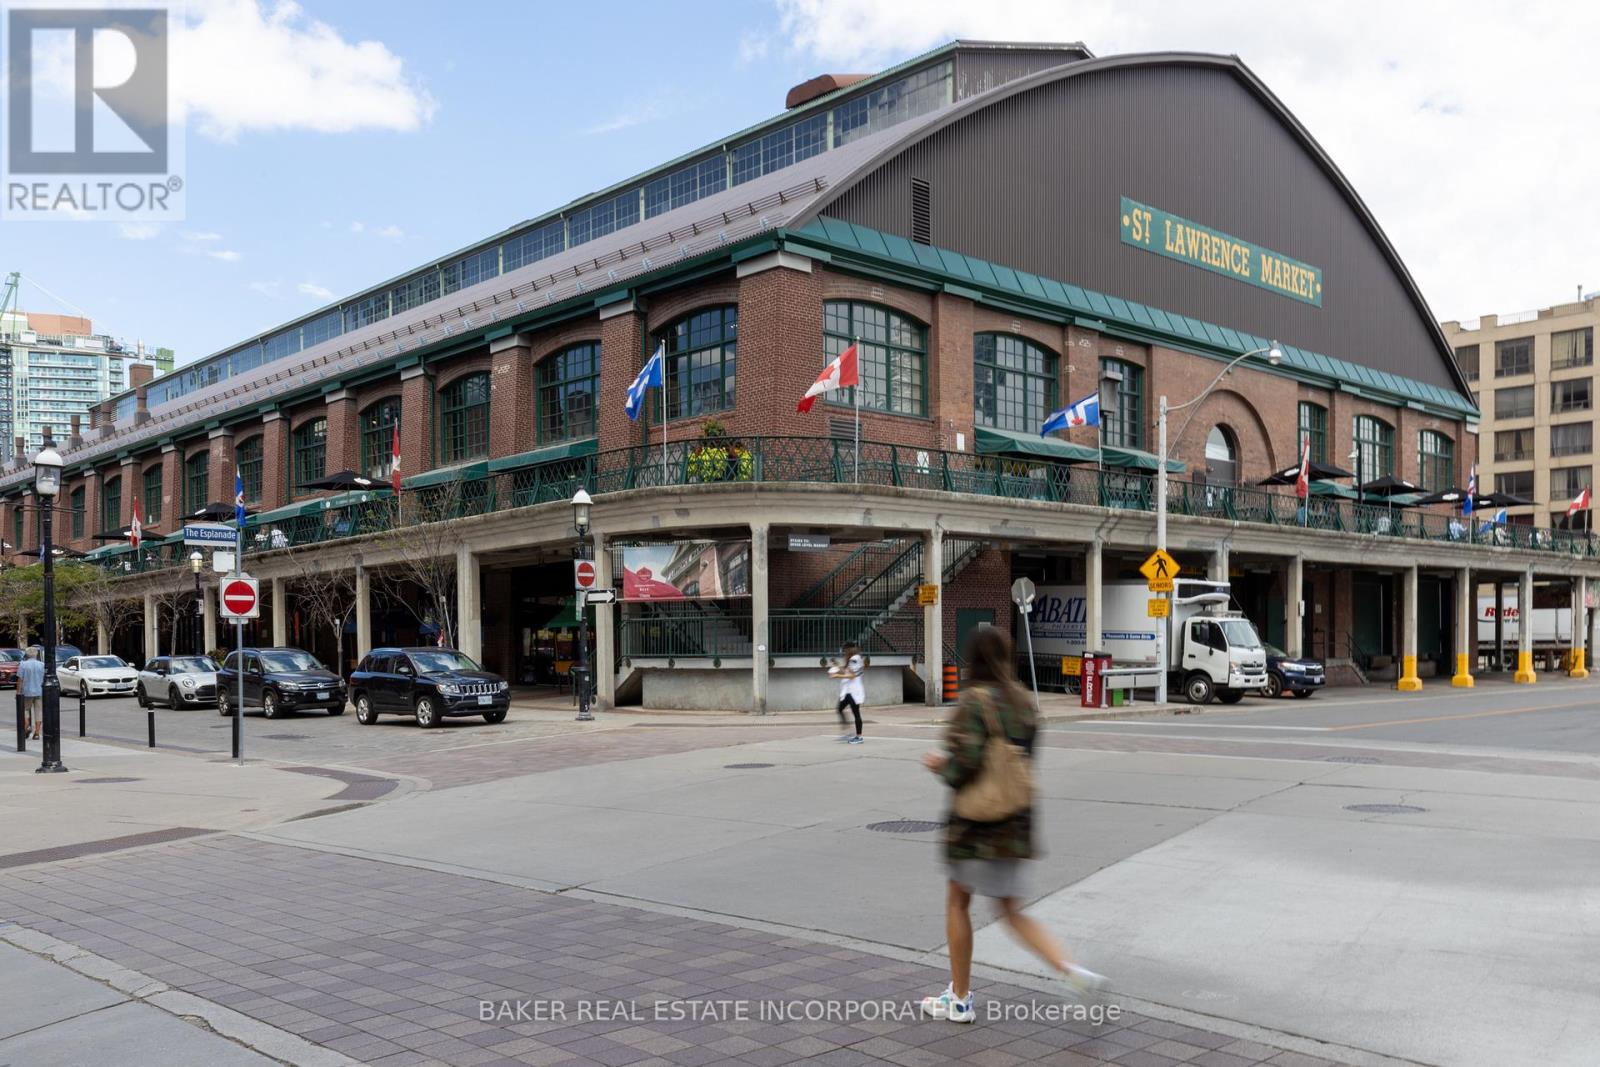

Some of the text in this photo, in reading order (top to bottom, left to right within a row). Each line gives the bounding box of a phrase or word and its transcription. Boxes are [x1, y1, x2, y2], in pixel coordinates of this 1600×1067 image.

[1165, 219, 1250, 277] LAWRENCE
[1260, 254, 1315, 300] MARKET
[185, 529, 236, 539] The Esplanade
